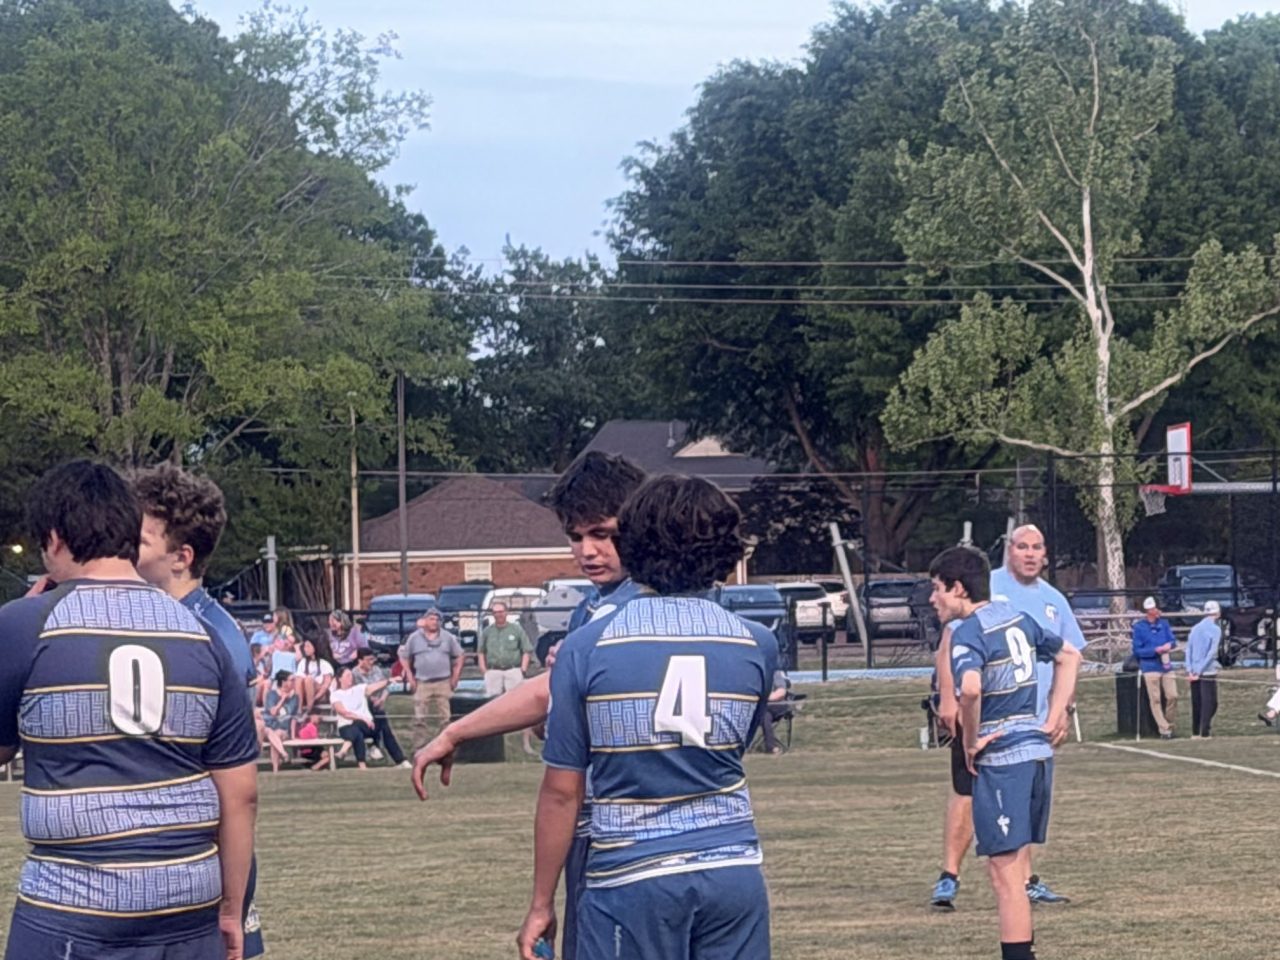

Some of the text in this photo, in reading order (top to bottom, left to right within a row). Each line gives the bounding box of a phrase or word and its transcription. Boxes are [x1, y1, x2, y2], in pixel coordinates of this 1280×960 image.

[108, 644, 165, 735] 0
[1005, 626, 1033, 684] 9
[654, 654, 712, 749] 4
